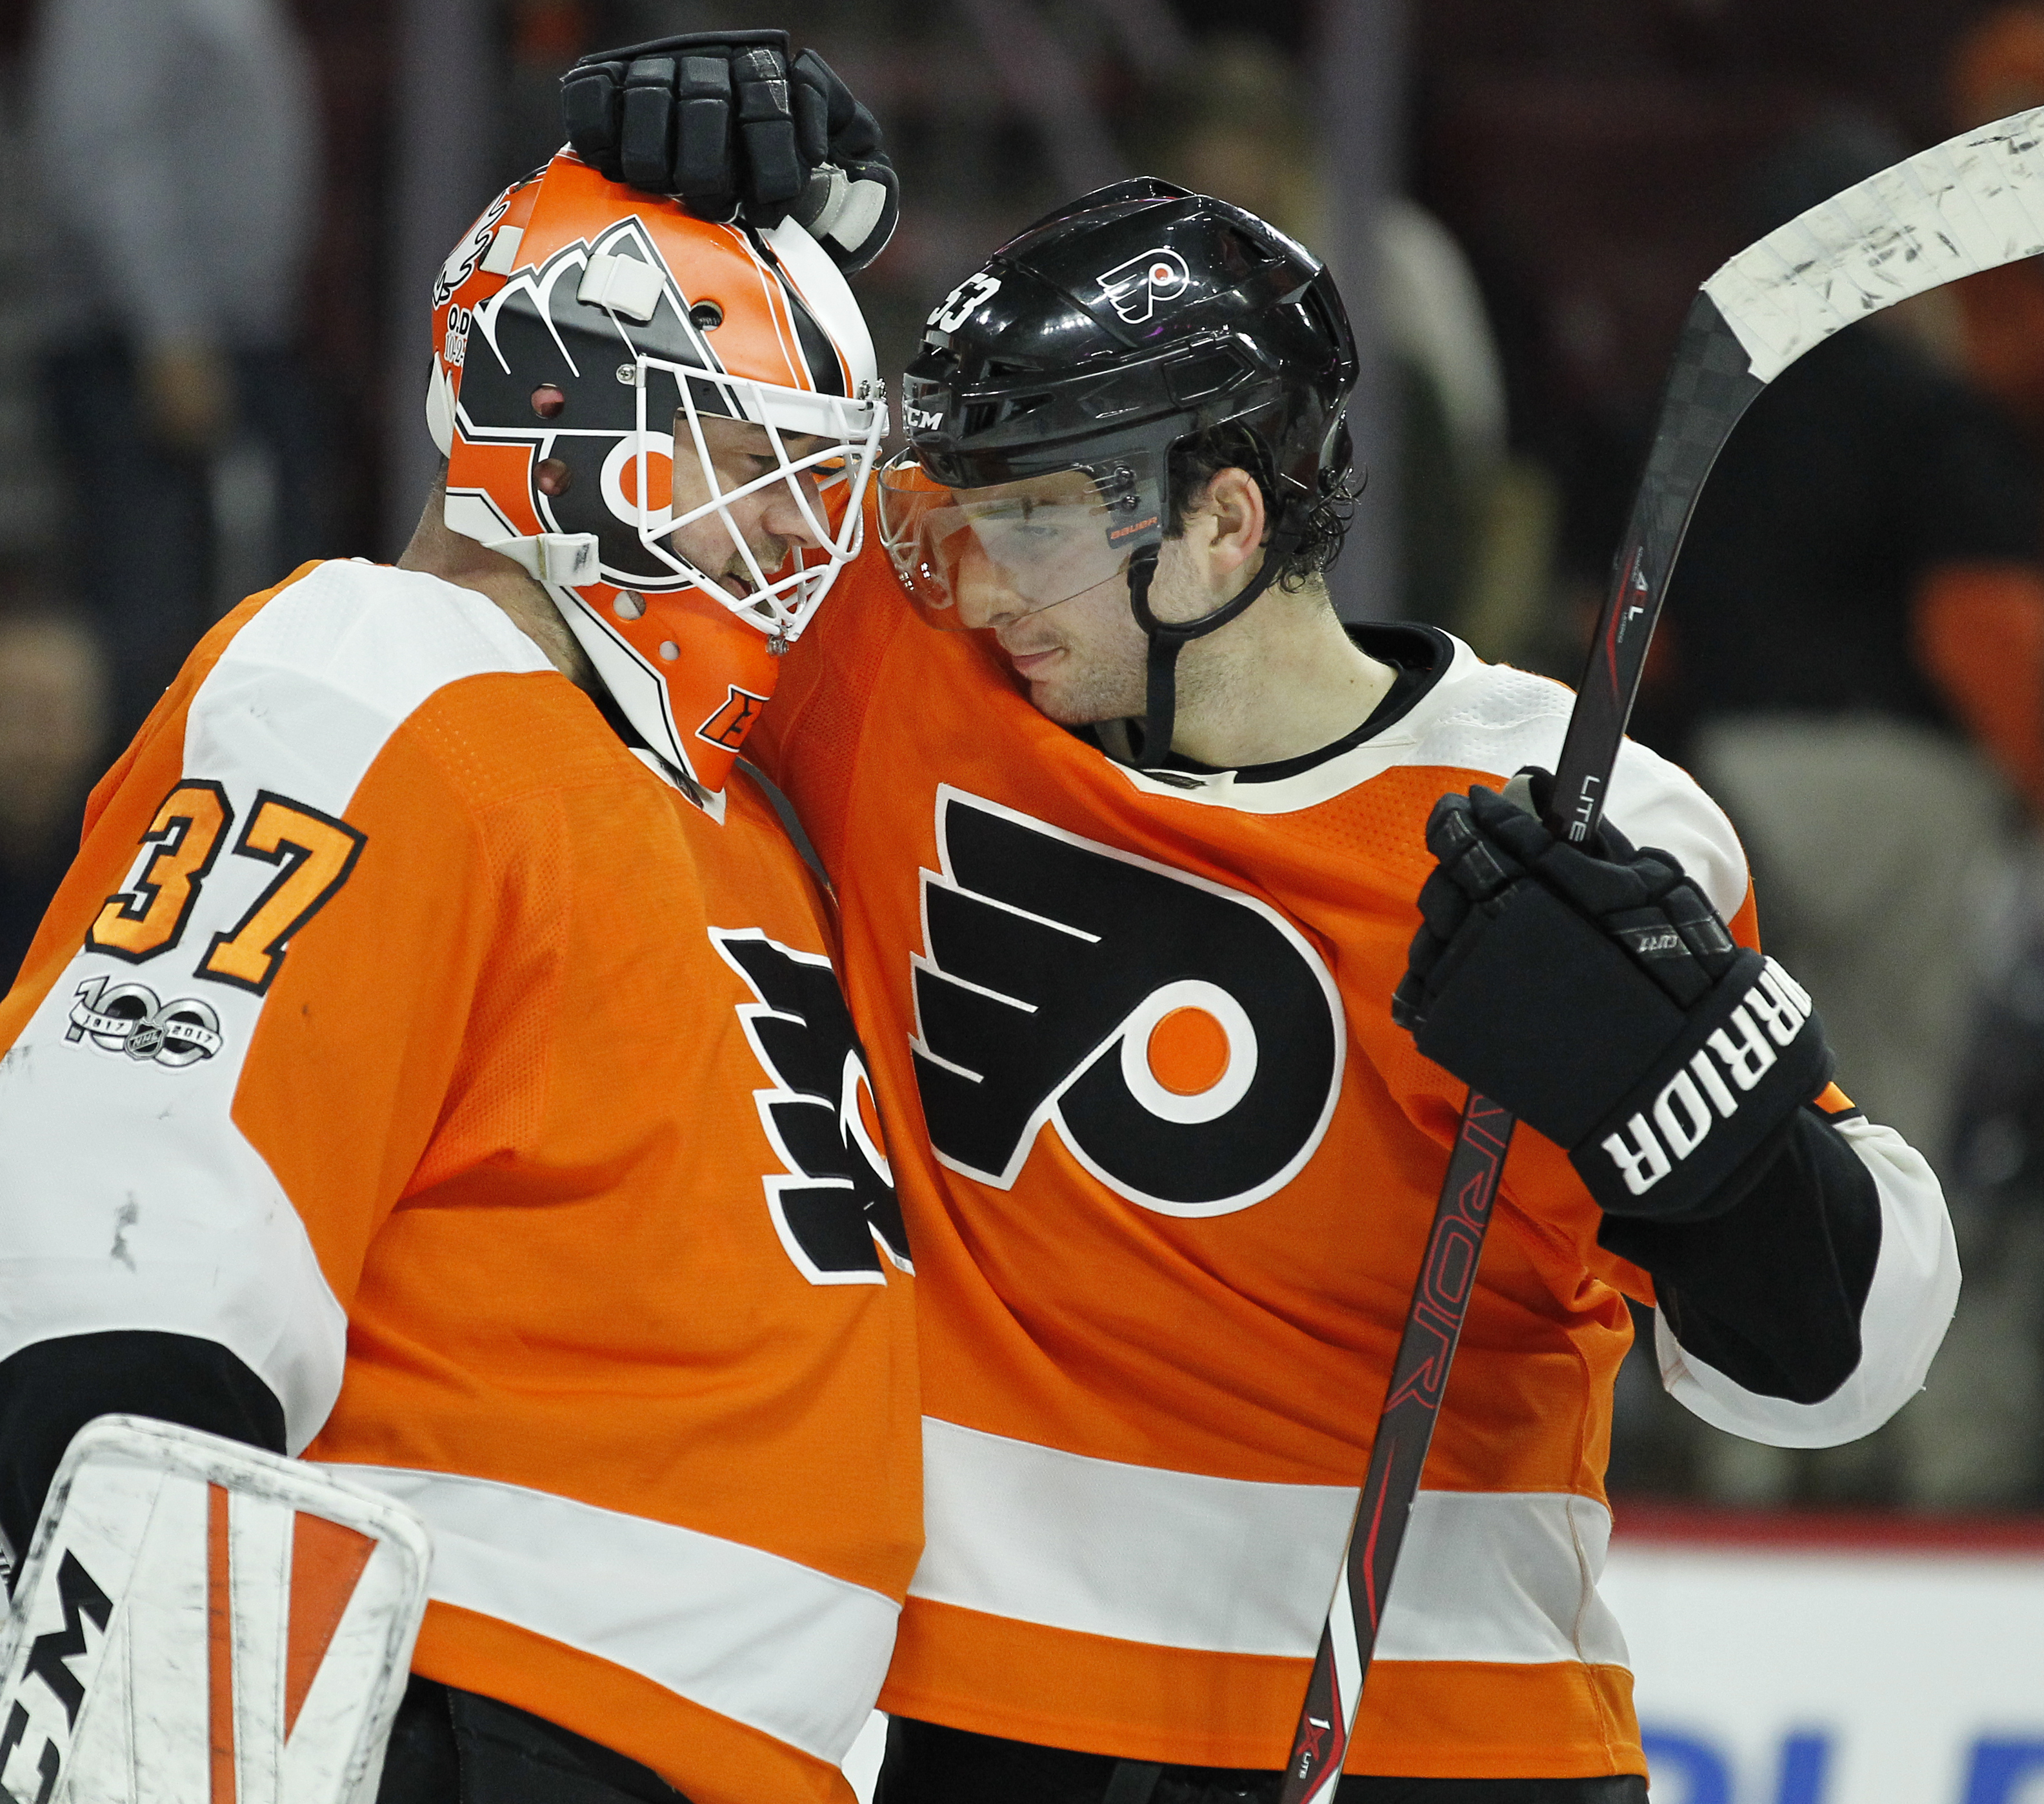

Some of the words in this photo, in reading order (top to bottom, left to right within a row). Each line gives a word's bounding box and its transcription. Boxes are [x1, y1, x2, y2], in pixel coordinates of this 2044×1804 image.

[927, 272, 1001, 333] 53
[903, 405, 943, 430] CM
[1568, 775, 1601, 842] LITE
[85, 779, 369, 997] 37
[65, 976, 223, 1068] 100
[170, 1025, 214, 1044] 2017
[1298, 1750, 1312, 1780] LITE
